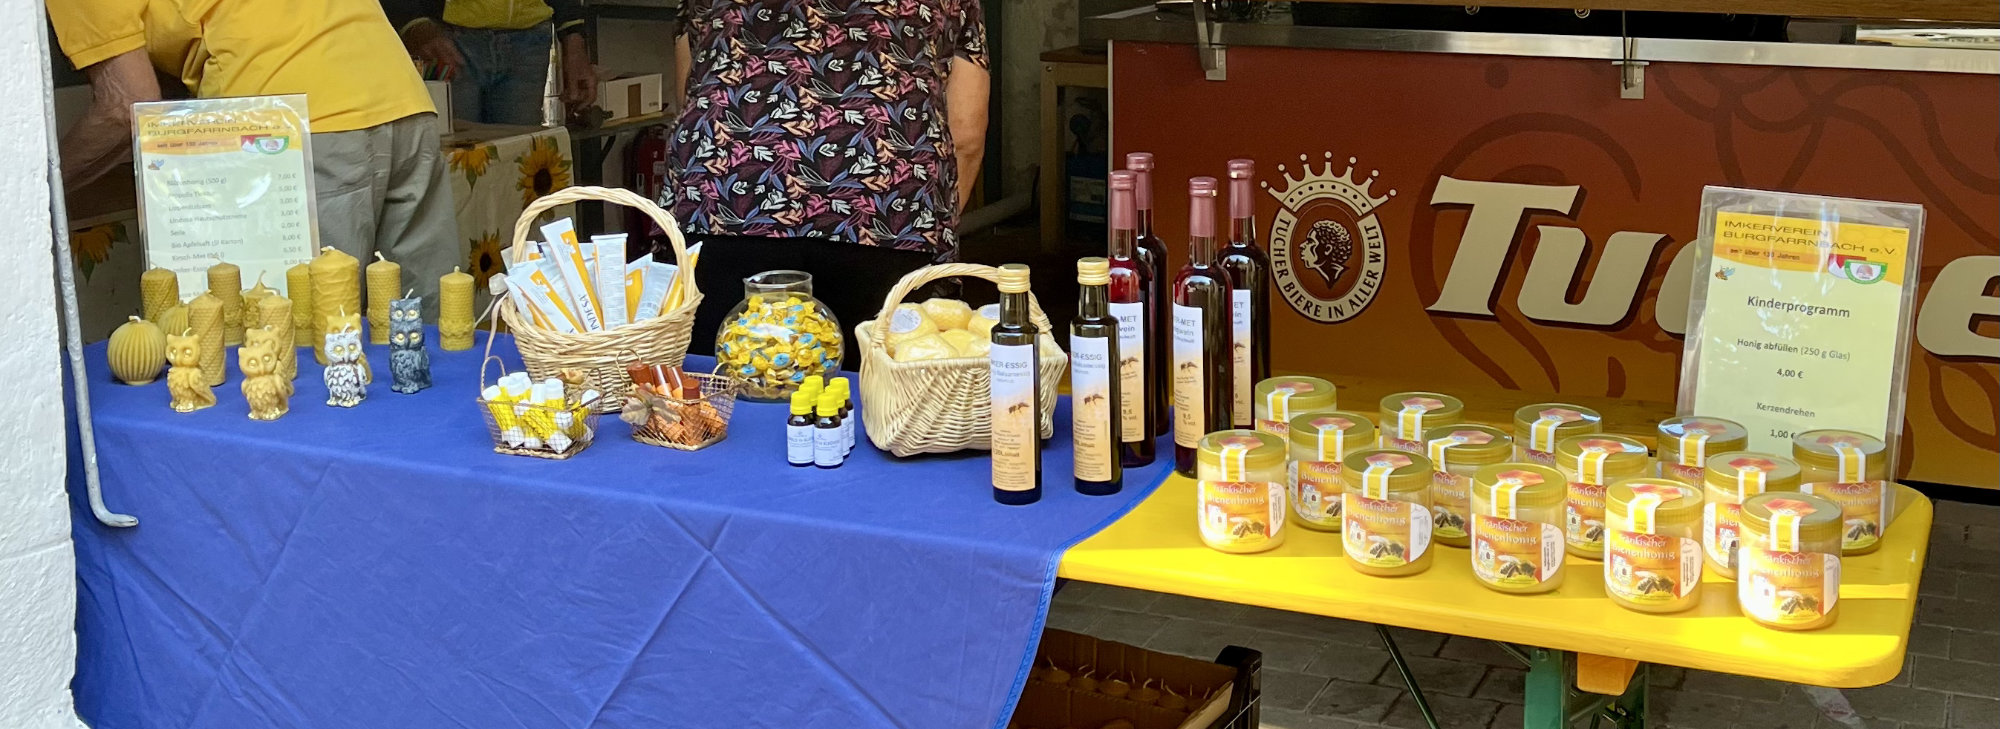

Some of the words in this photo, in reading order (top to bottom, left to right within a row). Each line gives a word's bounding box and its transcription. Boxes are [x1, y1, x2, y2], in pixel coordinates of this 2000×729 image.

[1724, 219, 1830, 237] IMKERVEREIN
[1273, 217, 1291, 279] TUCHER
[1363, 224, 1382, 264] WELT
[1723, 231, 1866, 254] BURGFARRNBACH
[1283, 280, 1322, 319] BIERE
[1348, 269, 1379, 313] ALLER
[1328, 303, 1344, 319] IN
[1747, 294, 1851, 319] Kinderprogramm
[1737, 338, 1762, 352] Honig
[1764, 340, 1799, 354] abfüllen
[1800, 345, 1820, 358] (250
[1821, 349, 1827, 360] g
[1829, 347, 1851, 362] Glas)
[1776, 367, 1796, 379] 4,00
[1797, 370, 1804, 379] €
[1756, 402, 1816, 419] Kerzendrehen
[1770, 429, 1789, 441] 1,00
